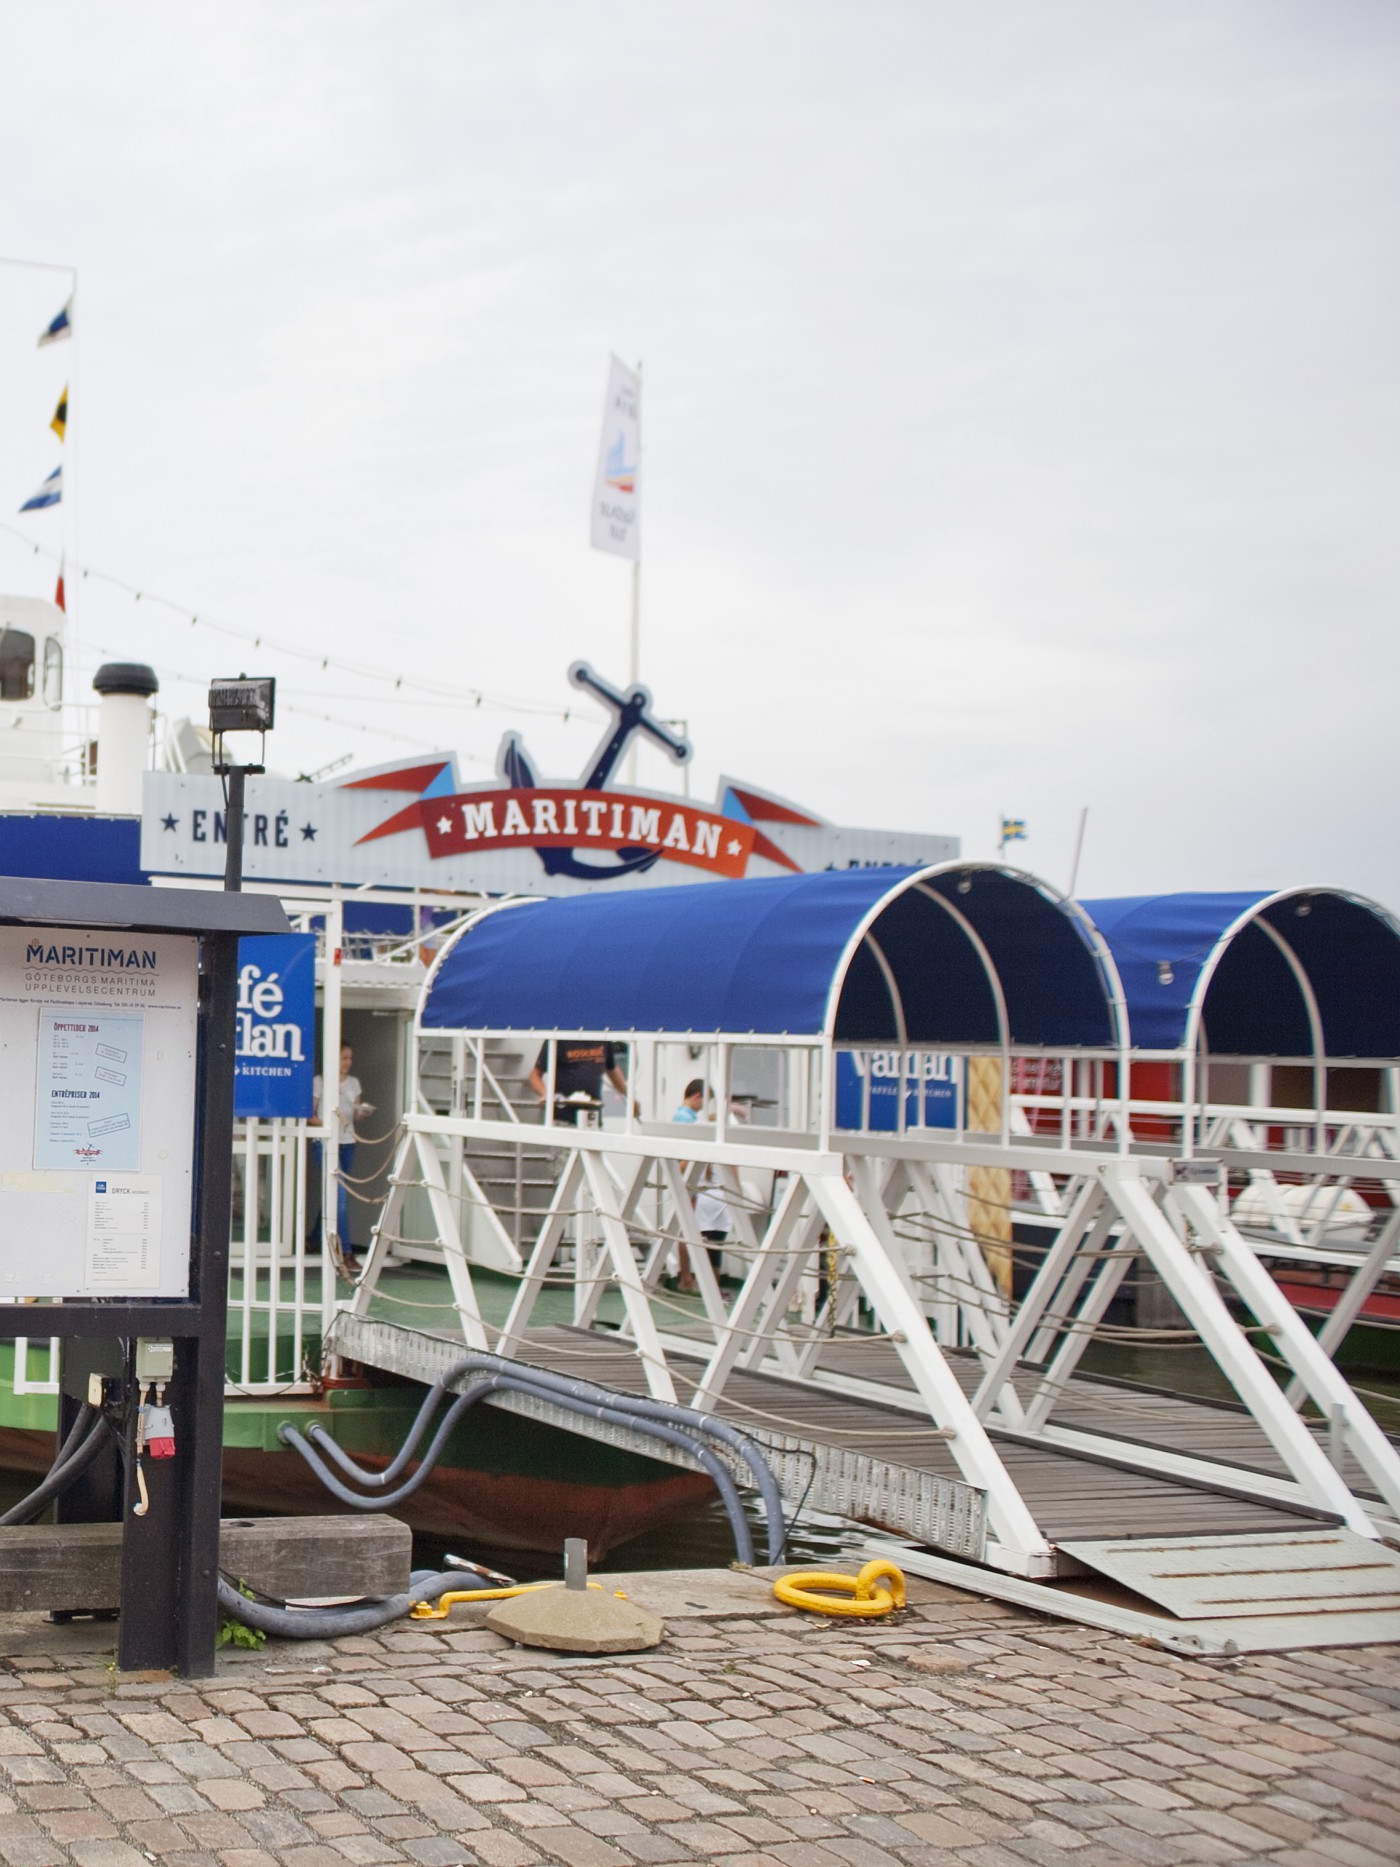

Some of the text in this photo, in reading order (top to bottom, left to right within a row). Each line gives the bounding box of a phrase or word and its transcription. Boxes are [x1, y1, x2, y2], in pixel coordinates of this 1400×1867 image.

[461, 799, 723, 859] MARITIMAN
[26, 944, 156, 969] MARITIMAN
[25, 972, 156, 987] GÖTEBORGS MARITIMA
[25, 983, 156, 997] UPPLEVELSECENTRUM
[54, 1022, 86, 1032] ÖPPETTIDER
[242, 1067, 291, 1076] KITCHEN
